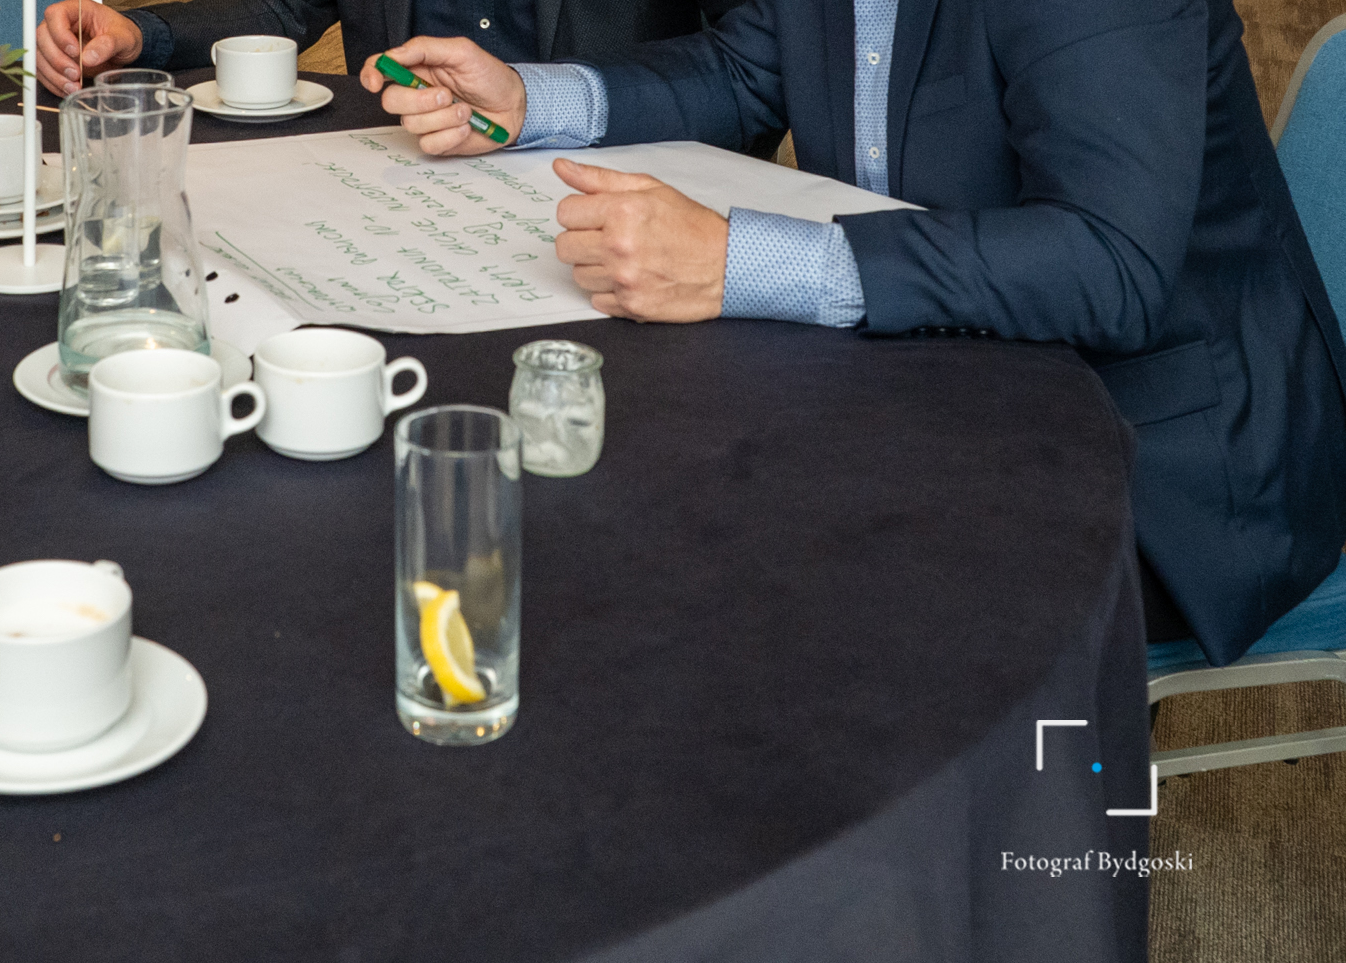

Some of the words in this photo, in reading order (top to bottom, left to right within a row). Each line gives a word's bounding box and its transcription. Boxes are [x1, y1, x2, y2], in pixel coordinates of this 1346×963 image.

[397, 185, 458, 218] BIZNES
[410, 218, 478, 256] CHCĄCE
[376, 270, 451, 314] SEKTOR
[397, 246, 499, 306] ZATRUDNIA
[479, 264, 553, 302] FIRMY
